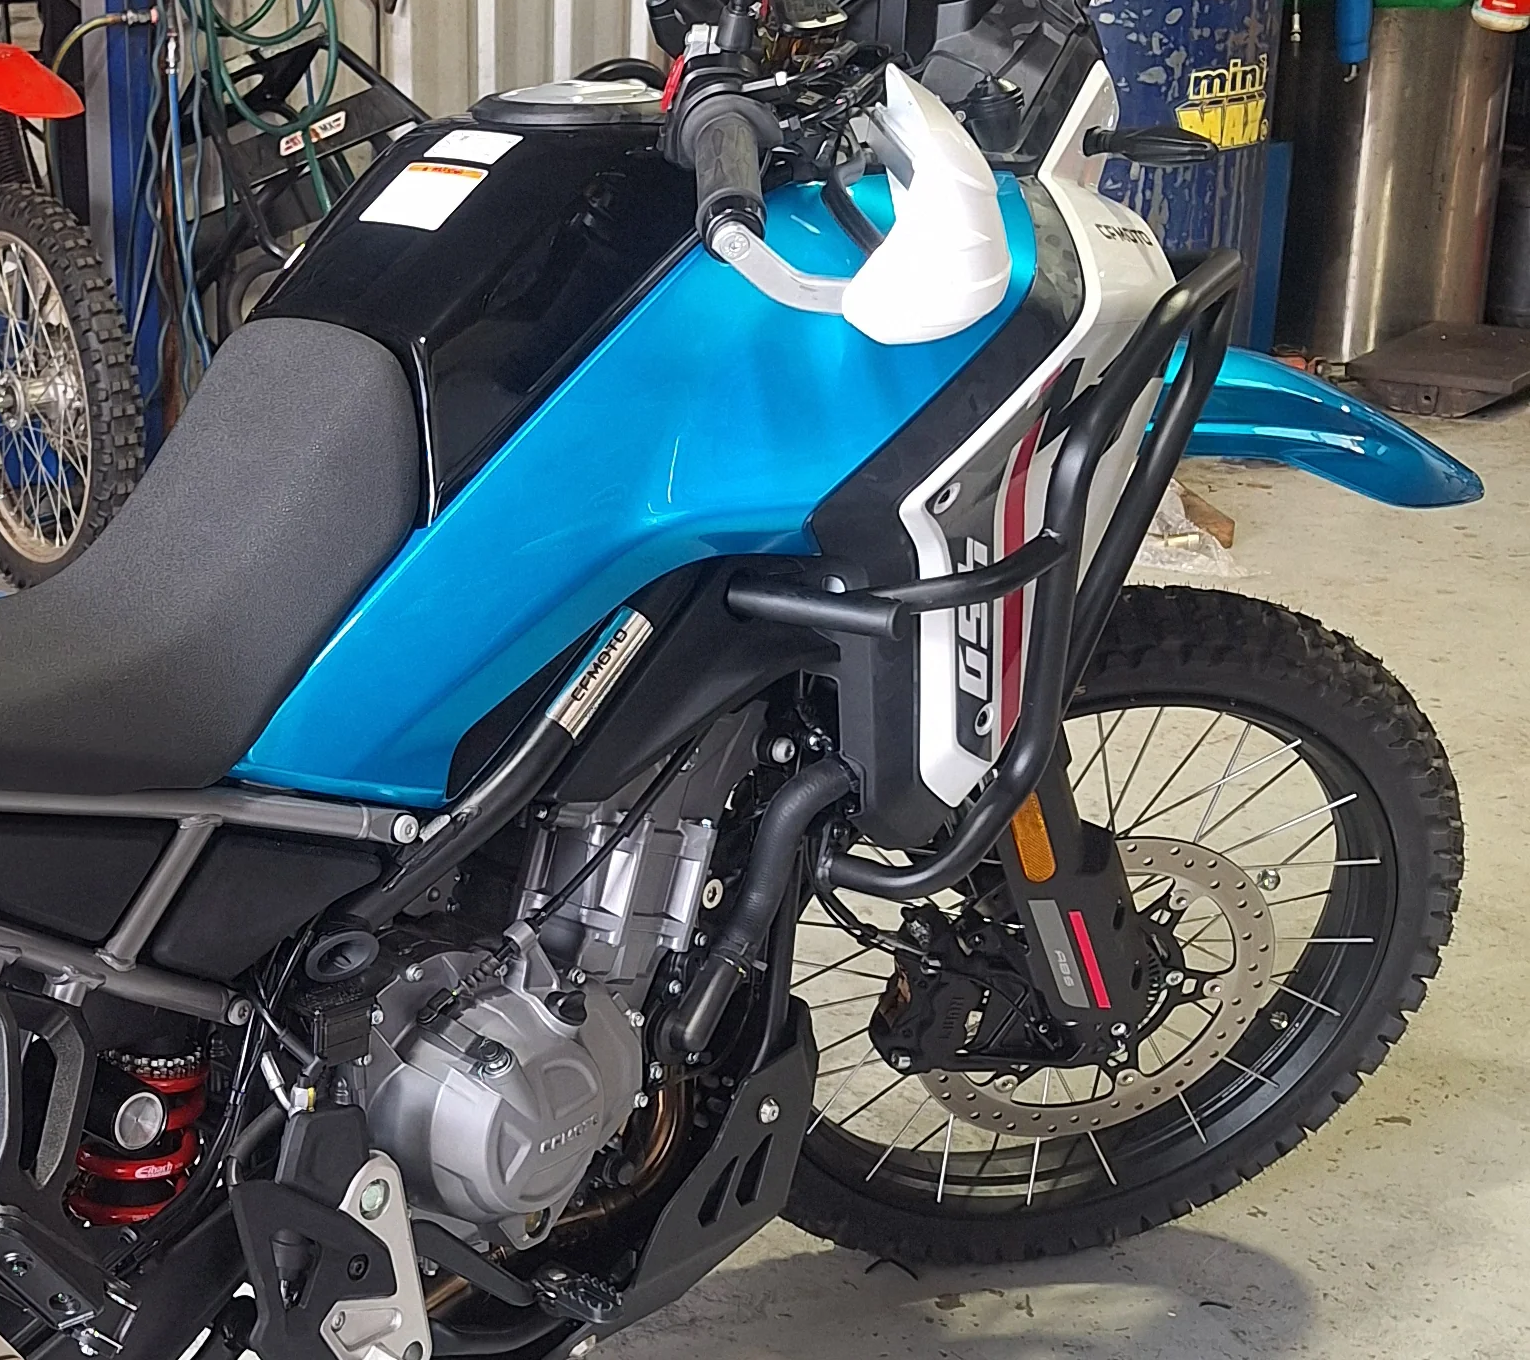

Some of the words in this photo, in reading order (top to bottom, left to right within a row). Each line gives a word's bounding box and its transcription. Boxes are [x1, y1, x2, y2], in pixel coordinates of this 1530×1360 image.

[1187, 52, 1268, 100] mini
[1174, 90, 1267, 152] MAX
[1094, 222, 1154, 247] CFMOTO
[957, 536, 989, 701] 450
[570, 627, 628, 702] CFMOTO
